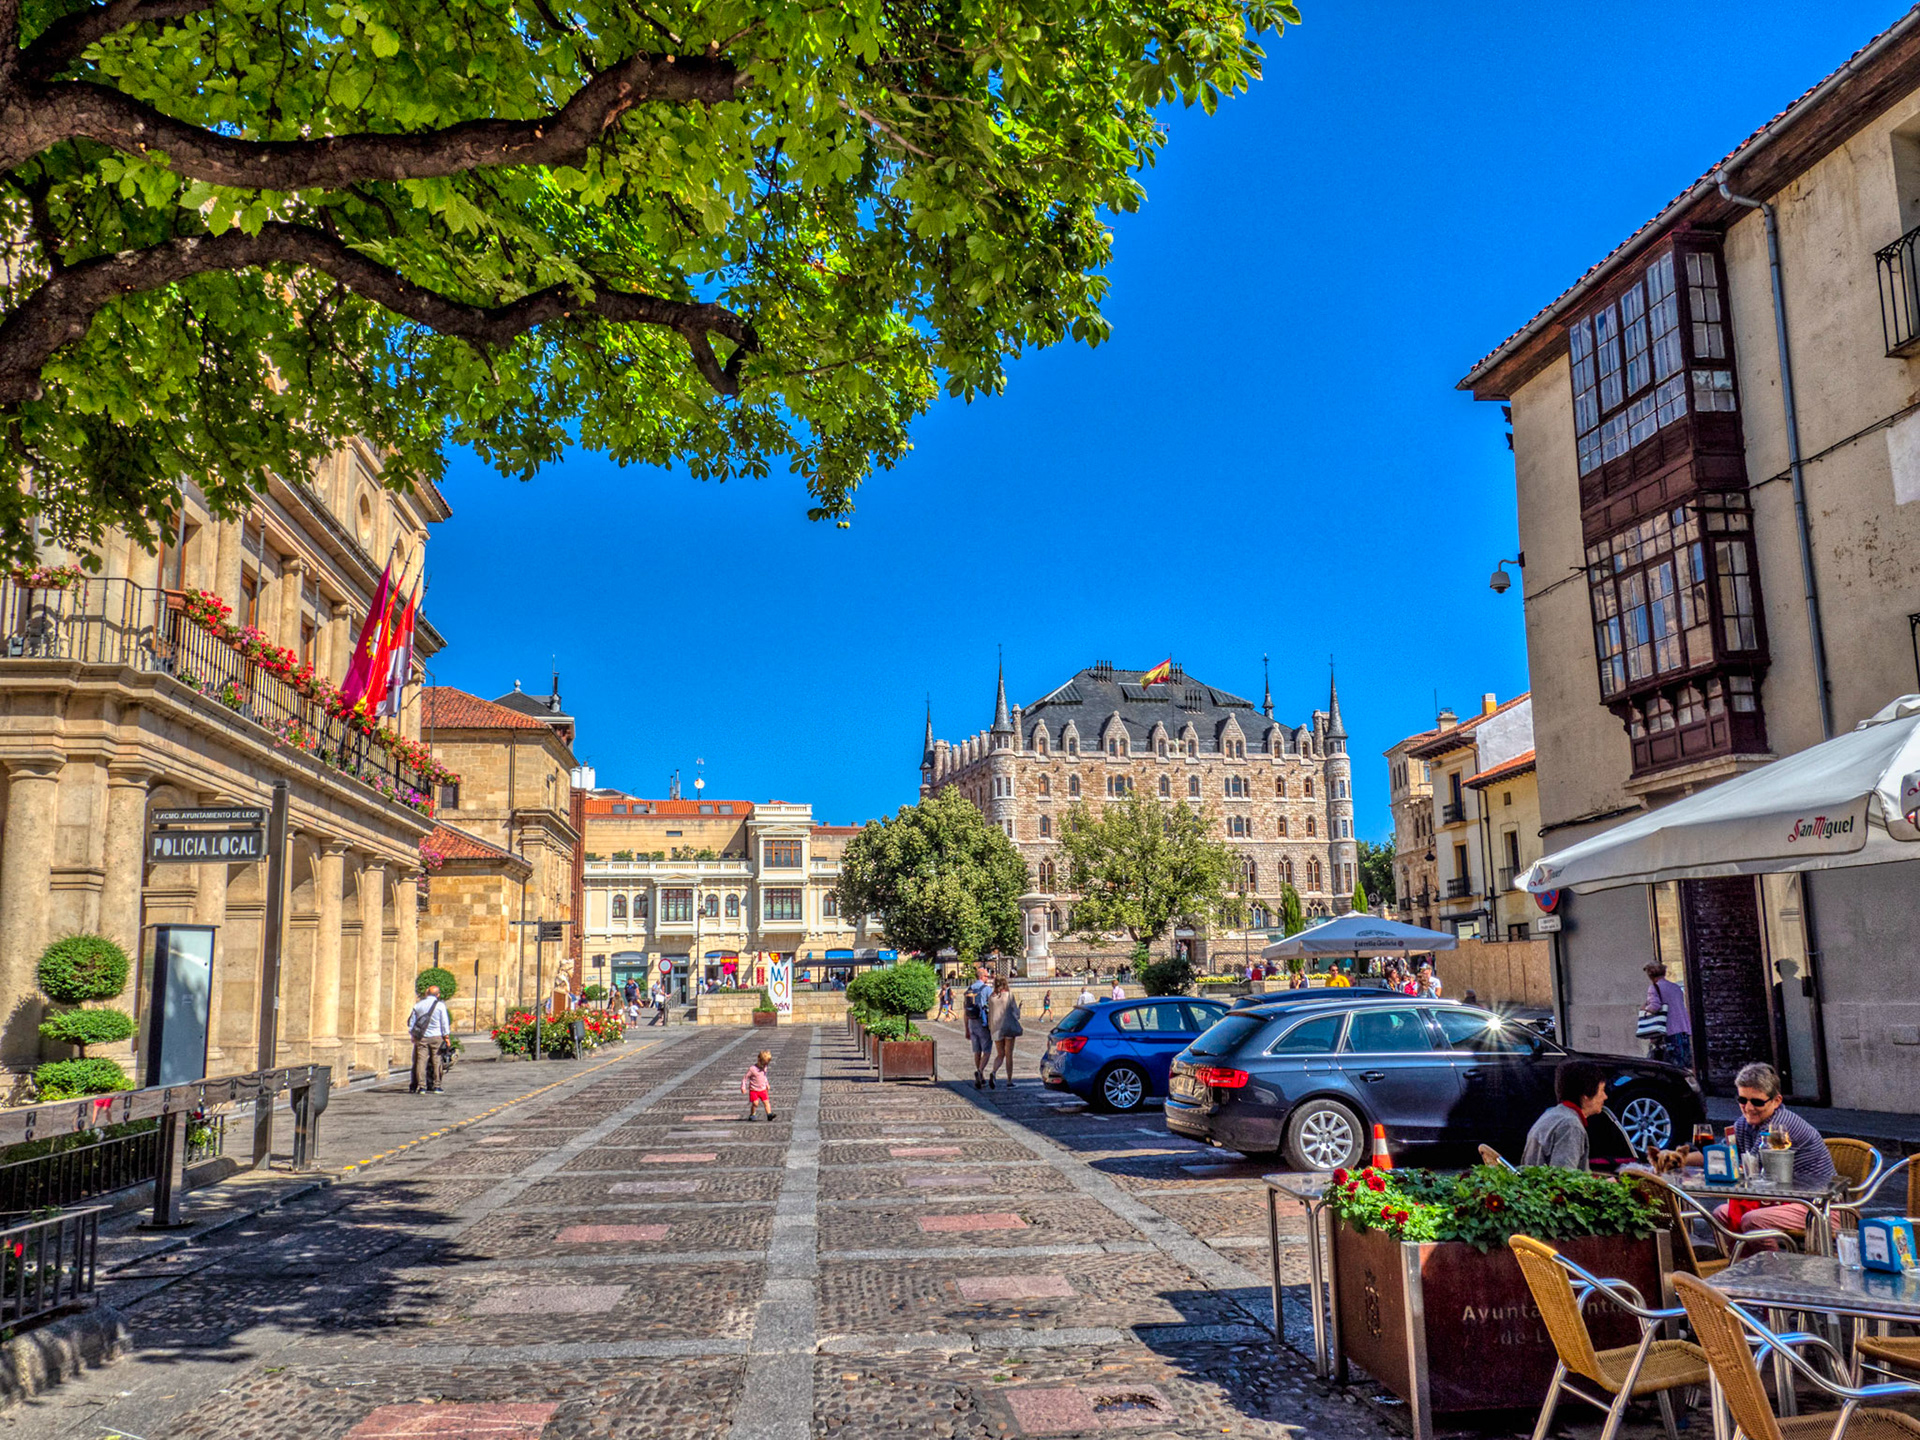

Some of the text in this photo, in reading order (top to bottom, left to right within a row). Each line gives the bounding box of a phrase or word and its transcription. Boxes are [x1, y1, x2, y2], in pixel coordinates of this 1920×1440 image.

[181, 811, 231, 820] AYUNTAMIENTO
[232, 811, 241, 819] DE
[153, 836, 257, 856] POLICIA LOCAL
[1462, 1299, 1622, 1324] Ayuntanto
